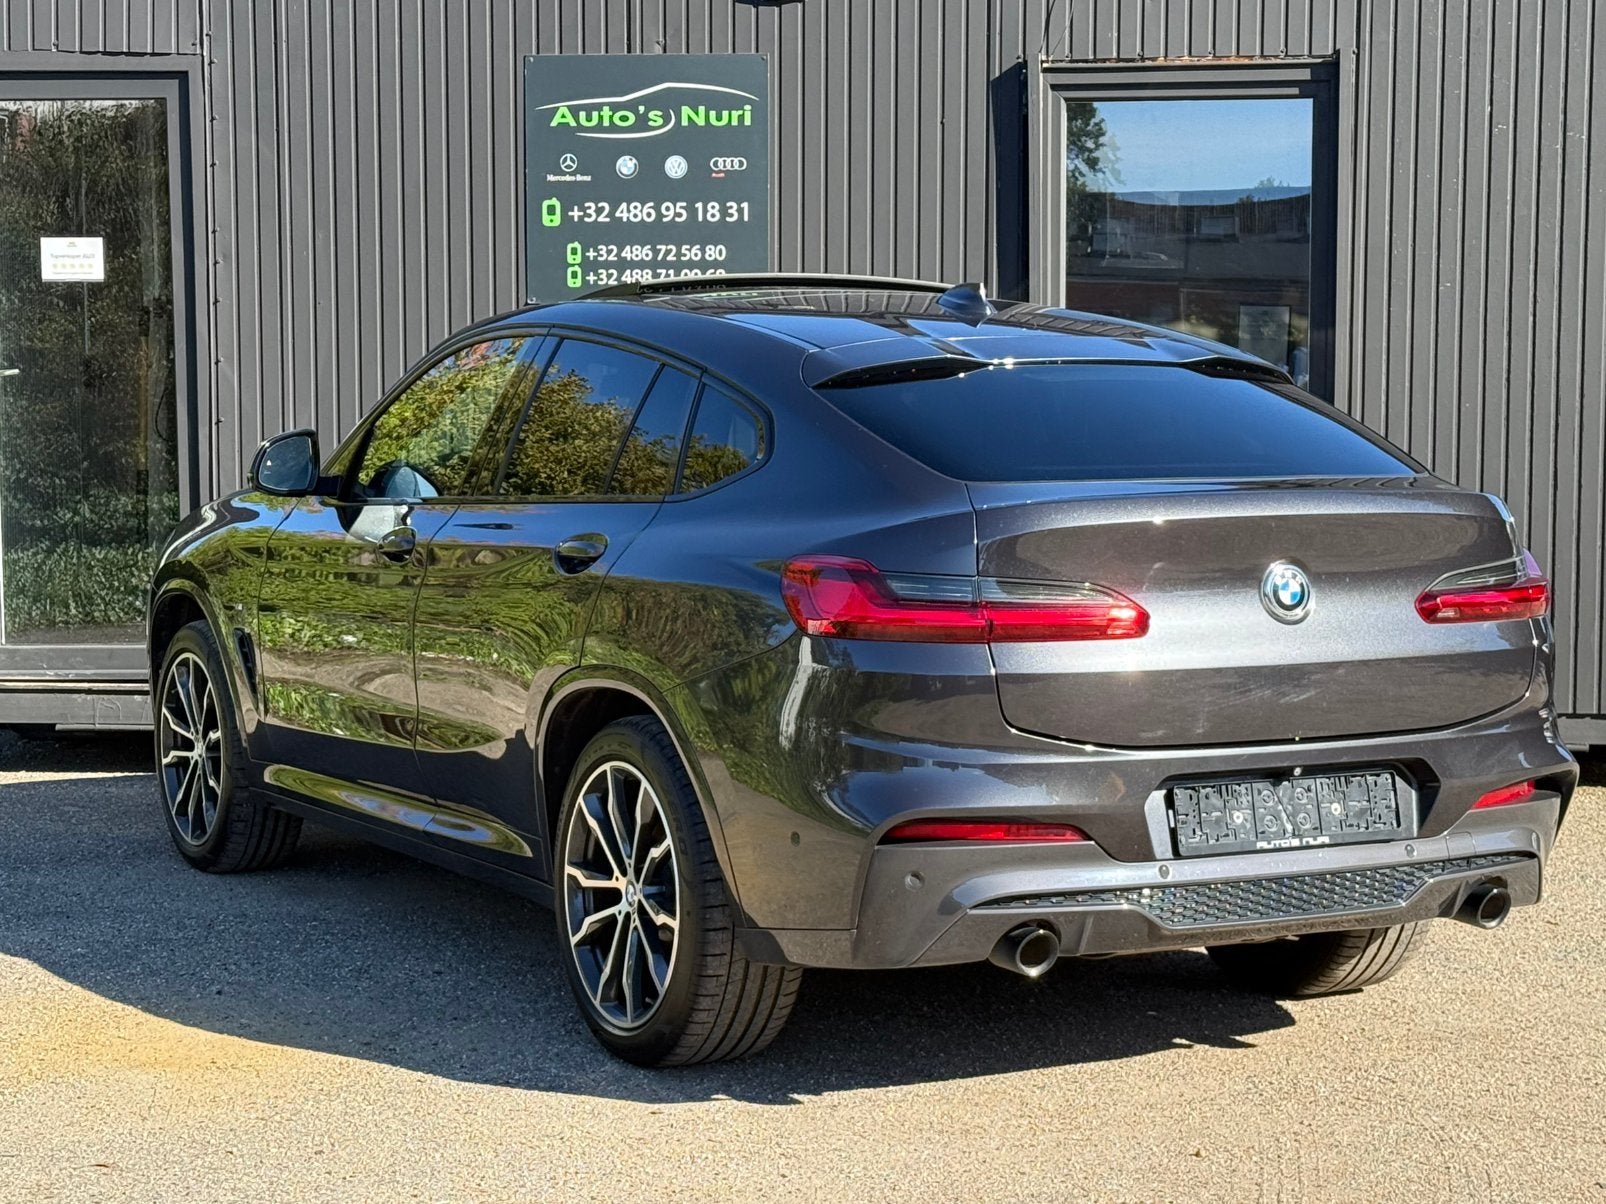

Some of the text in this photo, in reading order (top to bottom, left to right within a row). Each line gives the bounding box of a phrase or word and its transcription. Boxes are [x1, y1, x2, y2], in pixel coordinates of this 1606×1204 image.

[550, 105, 752, 127] Auto's Nuri
[568, 202, 750, 222] +32 486 95 18 31
[586, 245, 727, 261] +32 486 72 56 80
[586, 269, 618, 285] +32
